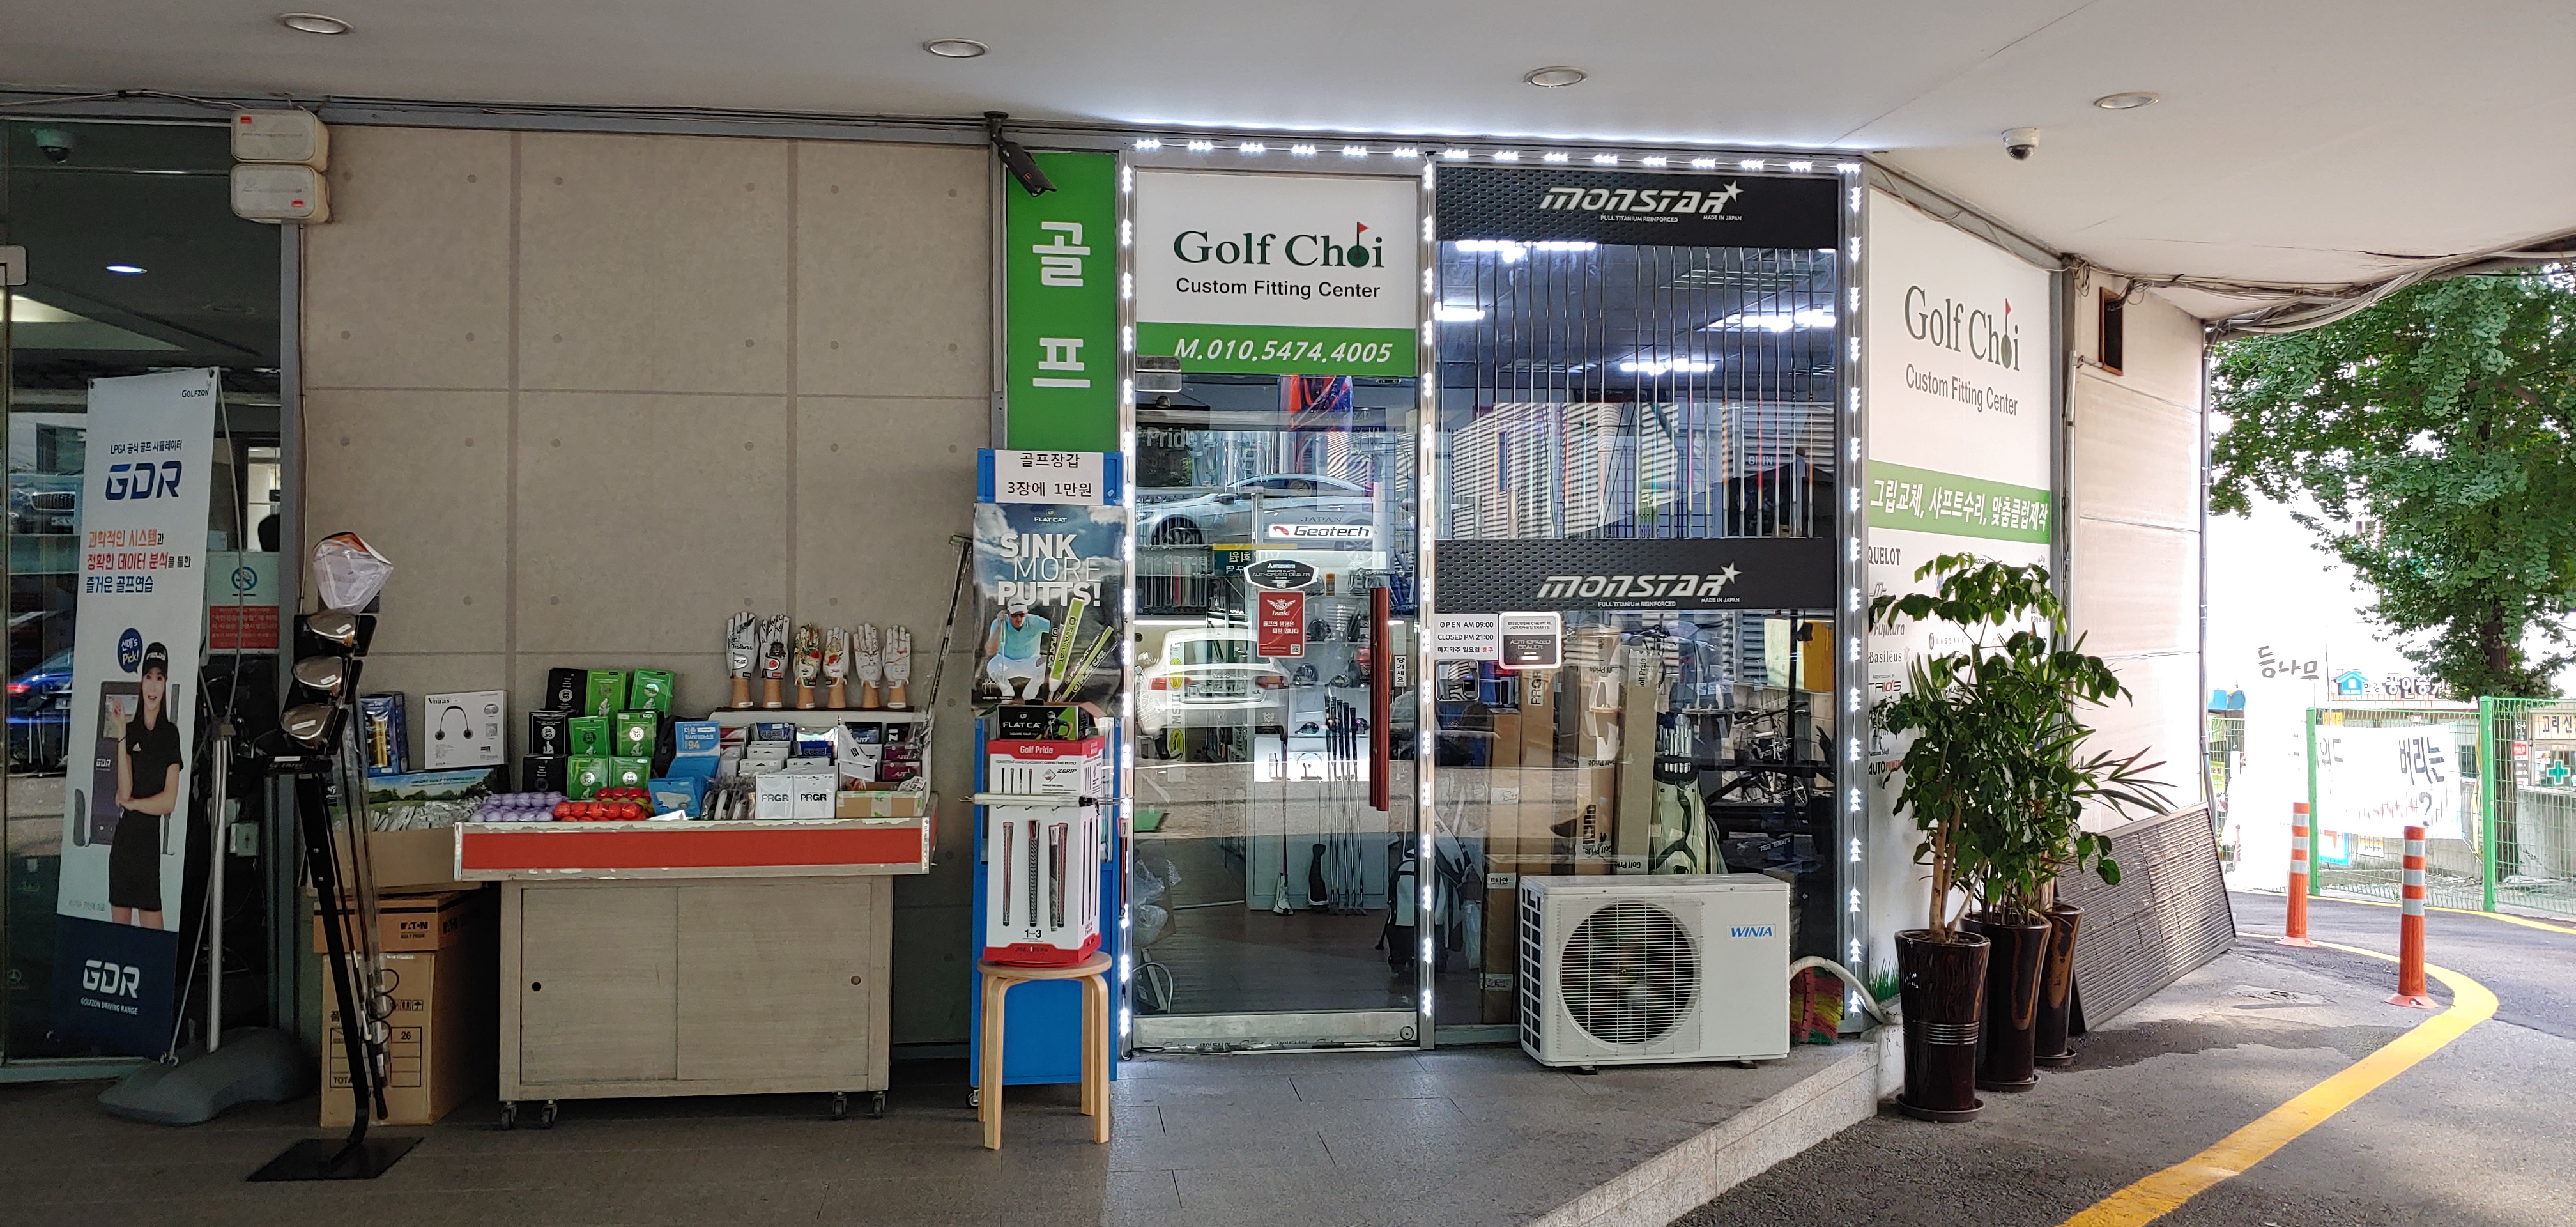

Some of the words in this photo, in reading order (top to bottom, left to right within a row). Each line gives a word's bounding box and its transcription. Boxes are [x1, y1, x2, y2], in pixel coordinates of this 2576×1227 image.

[1174, 230, 1276, 265] Golf
[1285, 231, 1384, 268] Choi
[1176, 277, 1247, 294] Custom
[1254, 280, 1312, 300] Fitting
[1319, 282, 1381, 298] Center
[1032, 221, 1091, 388] 골프
[1905, 285, 1964, 353] Golf
[1969, 309, 2020, 372] Choi
[1174, 338, 1393, 363] M.010.5474.4005
[182, 389, 210, 398] GOLFZON
[1906, 363, 1949, 398] Custom
[1952, 376, 1983, 413] Fitting
[1986, 386, 2018, 417] Center
[111, 444, 126, 454] LPGA
[127, 443, 139, 454] 공식
[140, 442, 151, 452] 골프
[153, 439, 183, 451] 시뮬레이터
[1020, 452, 1080, 468] 골프장갑
[105, 460, 183, 500] GDR
[1008, 481, 1046, 497] 3장에
[1054, 482, 1092, 497] 1만원
[1870, 479, 1925, 519] 그립교체,
[1991, 496, 2048, 532] 맞춤클럽제작
[88, 529, 125, 548] 과학적인
[128, 527, 164, 547] 시스템과
[1294, 525, 1370, 537] Geotech
[1000, 532, 1078, 559] SINK
[88, 552, 115, 571] 정확한
[117, 552, 146, 570] 데이터
[149, 552, 174, 570] 분석을
[176, 555, 191, 569] 통한
[1868, 546, 1901, 566] QUELOT
[1015, 556, 1101, 582] MORE
[86, 576, 113, 594] 즐거운
[116, 576, 153, 594] 골프연습
[998, 580, 1101, 607] PUTTS!
[122, 650, 139, 665] Pick!
[1869, 649, 1902, 663] Basiléus
[1396, 657, 1406, 683] 당기세요
[2364, 683, 2381, 693] 한강
[1020, 745, 1034, 754] Golf
[1035, 745, 1054, 754] Pride
[96, 759, 111, 767] GDR
[762, 794, 789, 802] PRGR
[800, 793, 827, 801] PRGR
[1628, 861, 1641, 869] Golf
[1730, 926, 1774, 938] WINIA
[82, 959, 140, 999] GDR
[80, 997, 101, 1008] GOLFZON
[101, 1001, 120, 1012] DRIVING
[120, 1005, 138, 1015] RANGE
[401, 1031, 411, 1040] 26
